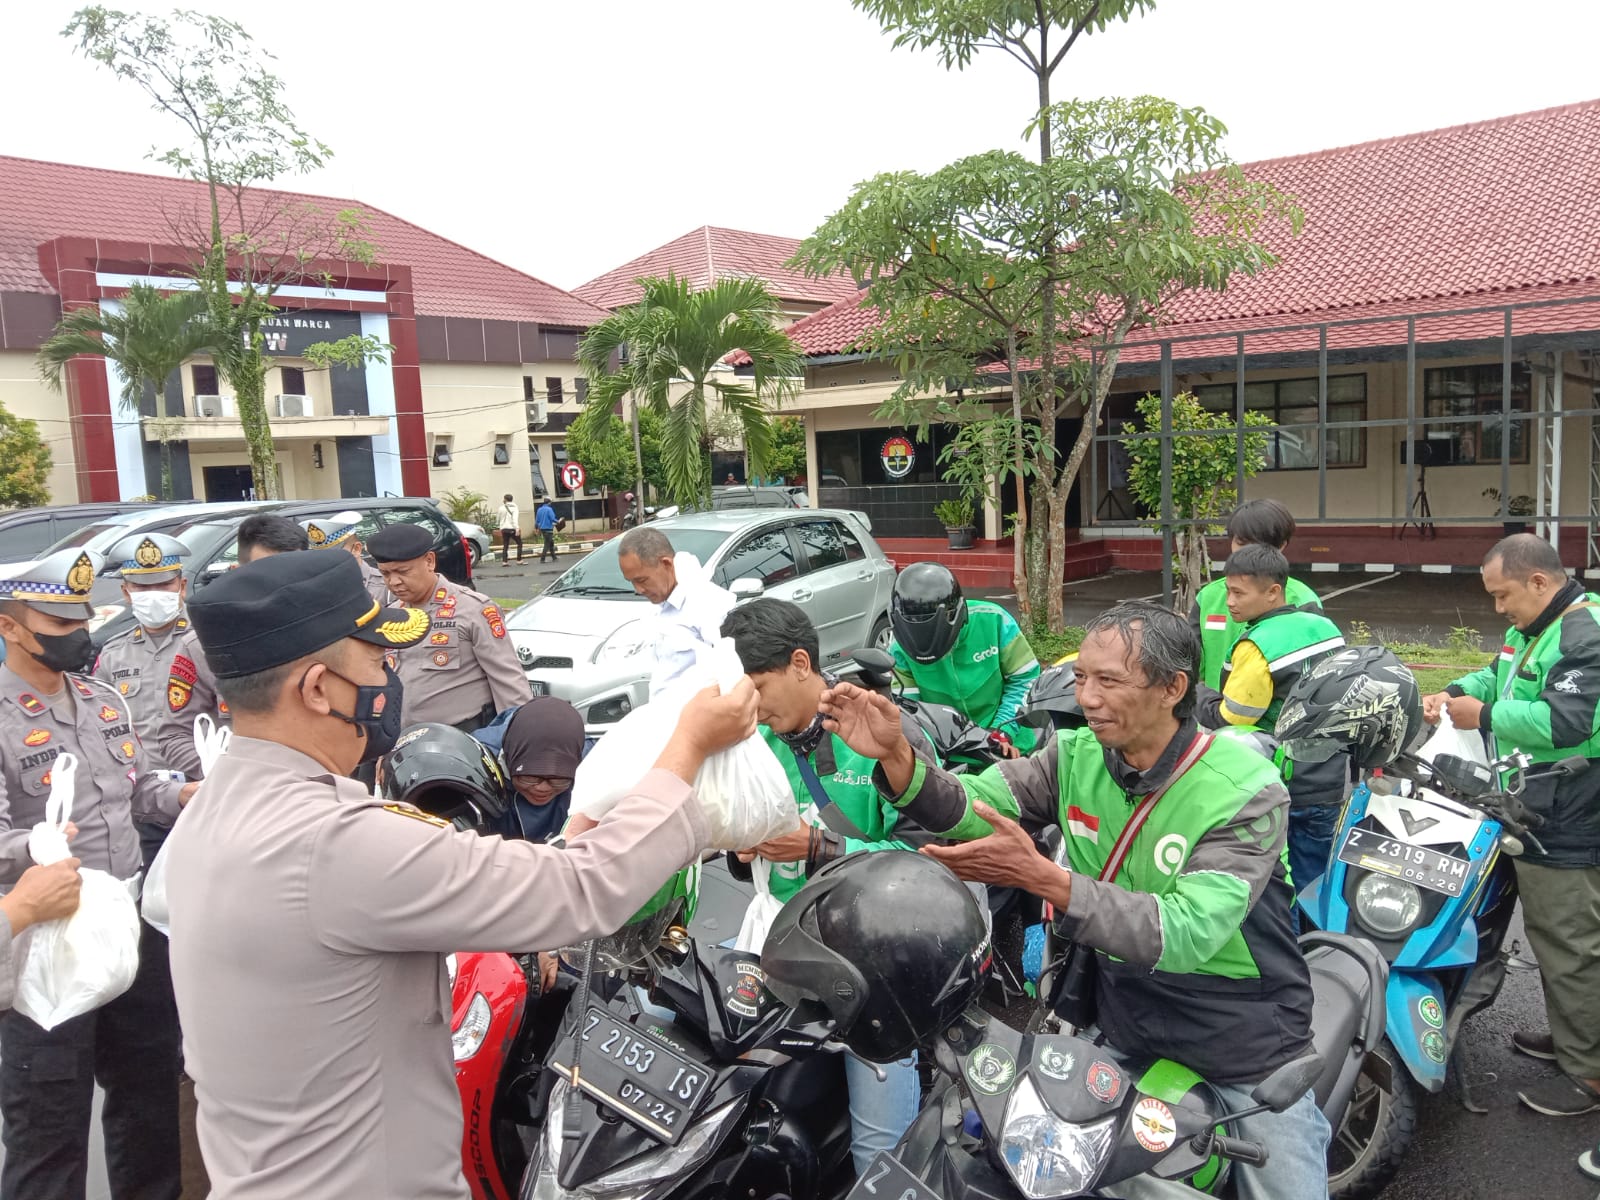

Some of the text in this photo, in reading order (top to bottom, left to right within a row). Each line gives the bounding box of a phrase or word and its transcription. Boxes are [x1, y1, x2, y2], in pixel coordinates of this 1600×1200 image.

[294, 319, 331, 329] WARGA
[973, 645, 998, 662] Grab
[1348, 832, 1362, 846] Z
[1377, 841, 1425, 864] 4319
[1437, 858, 1465, 878] RM
[582, 1016, 599, 1040] Z
[600, 1030, 655, 1072] 2153
[668, 1068, 698, 1099] IS
[864, 1161, 891, 1195] Z
